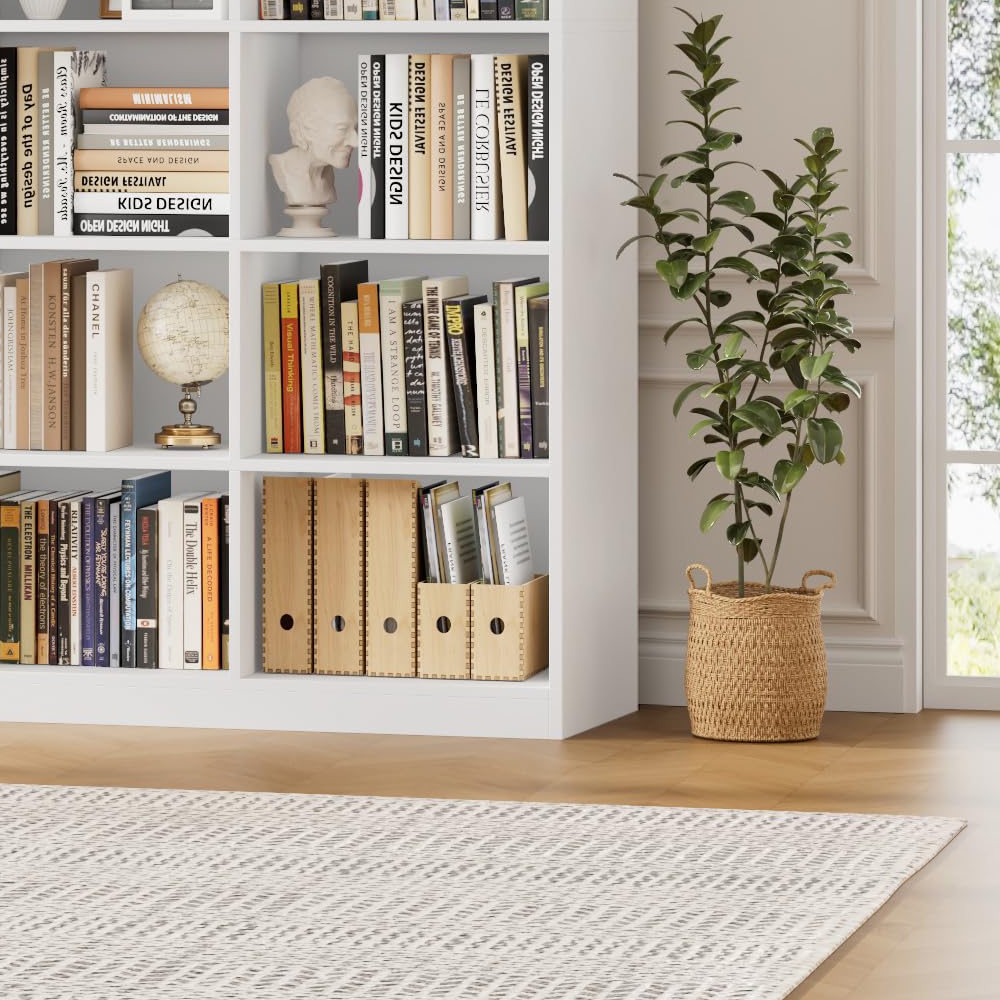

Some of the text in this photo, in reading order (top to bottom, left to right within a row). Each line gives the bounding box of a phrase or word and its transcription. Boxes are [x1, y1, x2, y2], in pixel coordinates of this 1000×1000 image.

[91, 283, 101, 339] CHANEL
[388, 308, 397, 324] AM
[447, 305, 463, 335] IMPRO
[286, 323, 295, 392] Visual Thinking
[389, 340, 398, 392] STRANGE
[392, 397, 400, 429] LOOP
[24, 506, 33, 601] THE ELECTRON MILLIKAN
[185, 522, 198, 595] The Double Helix
[38, 538, 47, 629] the theory of electrons
